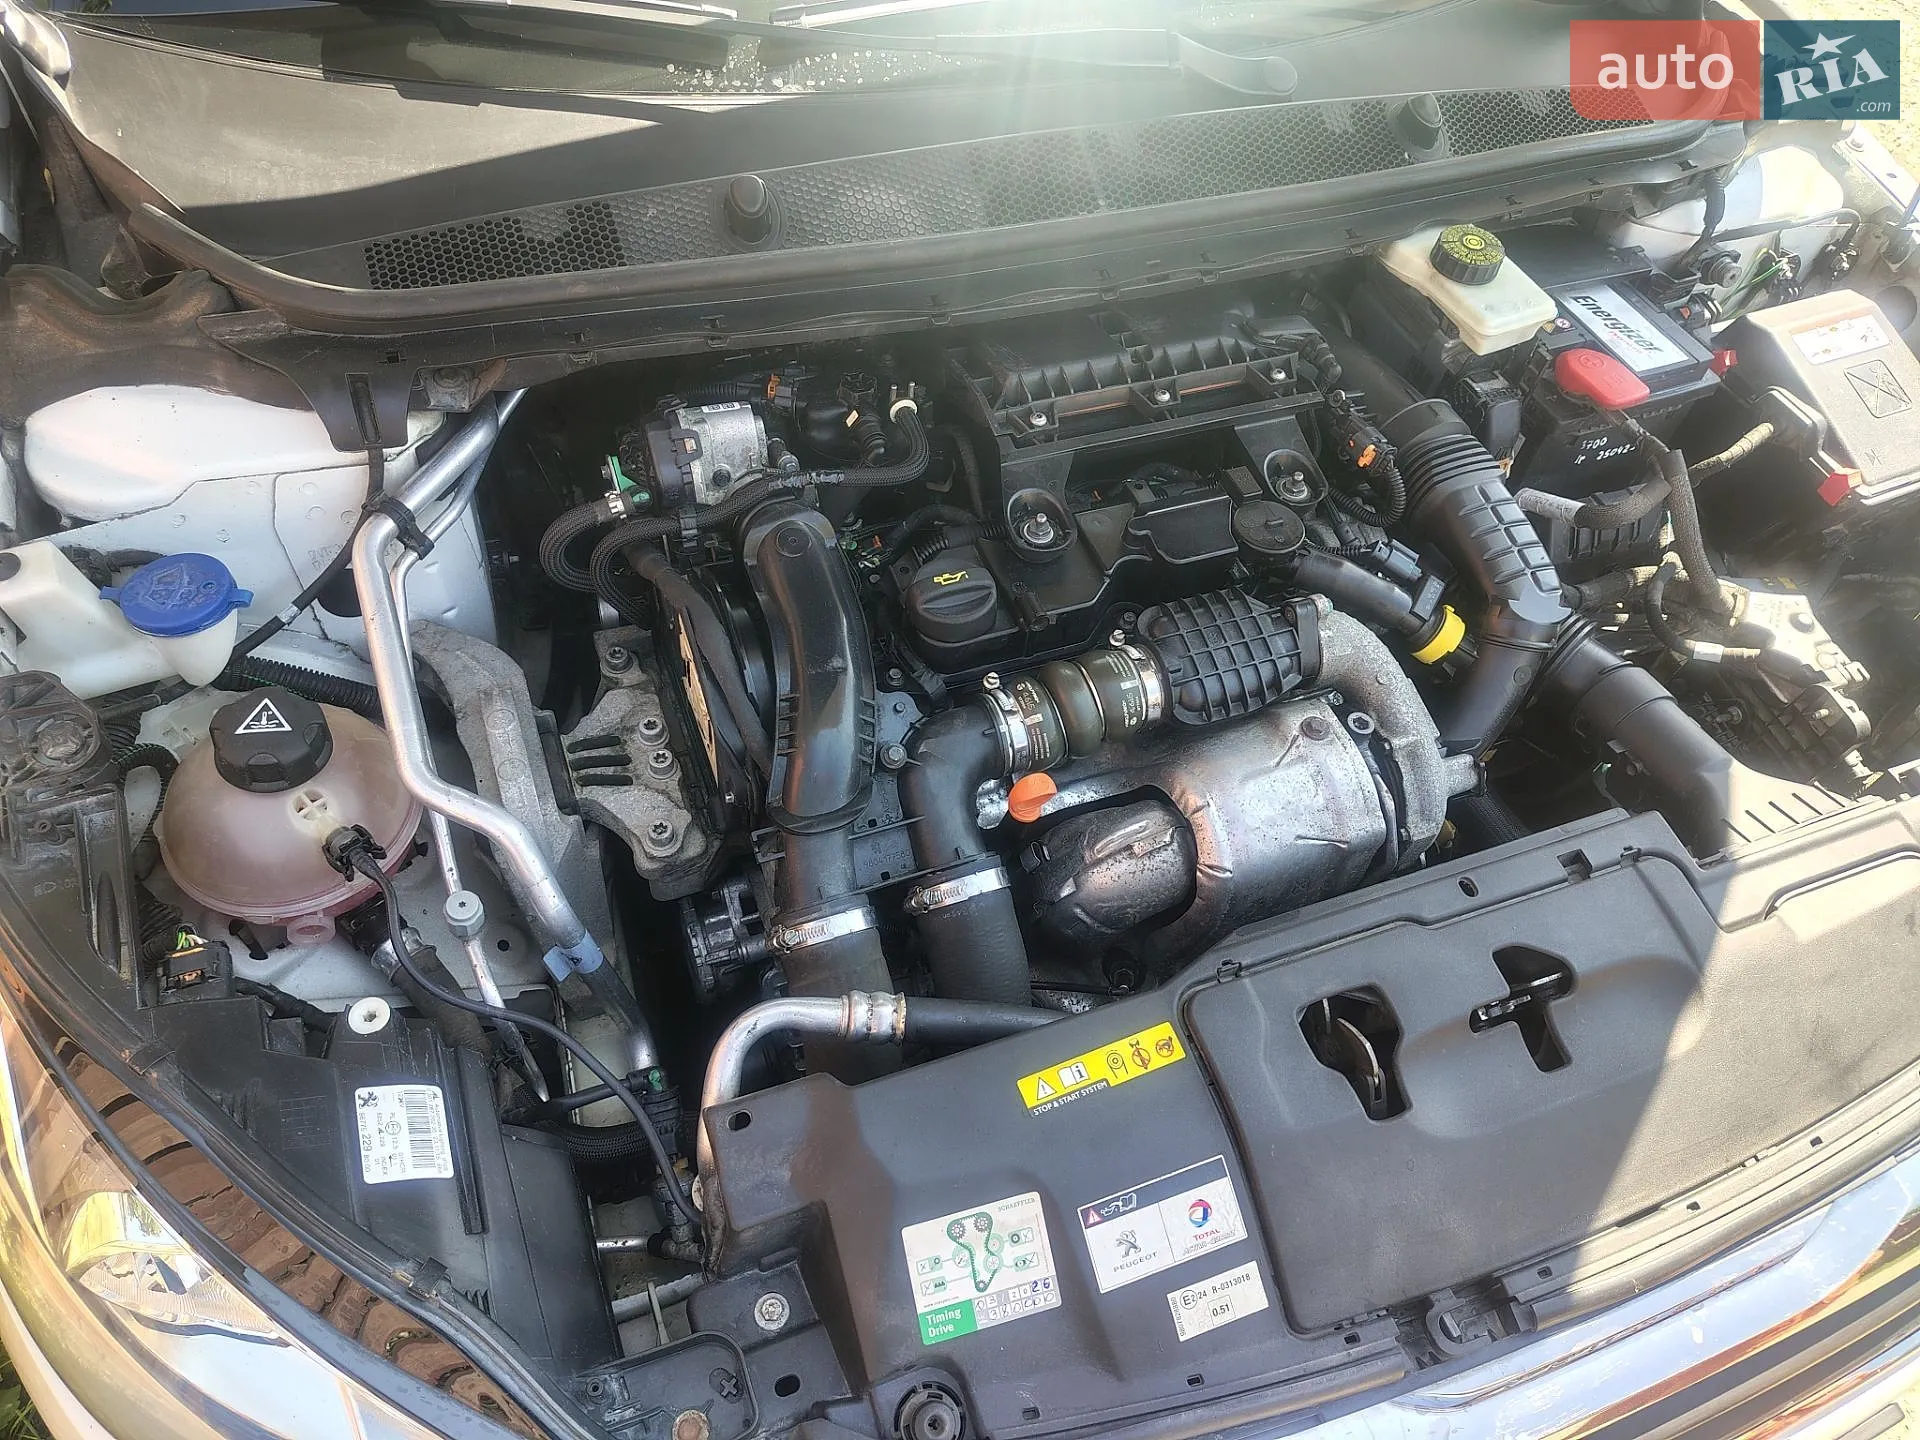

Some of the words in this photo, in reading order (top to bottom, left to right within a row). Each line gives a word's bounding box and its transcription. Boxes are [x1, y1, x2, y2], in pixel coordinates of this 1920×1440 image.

[1572, 296, 1663, 352] Energizer
[1033, 1102, 1052, 1116] STOP
[1053, 1100, 1059, 1108] &
[1059, 1091, 1081, 1105] START
[1081, 1080, 1108, 1097] SYSTEM
[361, 1132, 372, 1152] 229
[1192, 1229, 1221, 1241] TOTAL
[1113, 1251, 1158, 1272] PEUGEOT
[1211, 1273, 1251, 1294] R-0313018
[926, 1309, 962, 1325] Timing
[1212, 1303, 1230, 1317] 0.51
[928, 1324, 954, 1337] Drive
